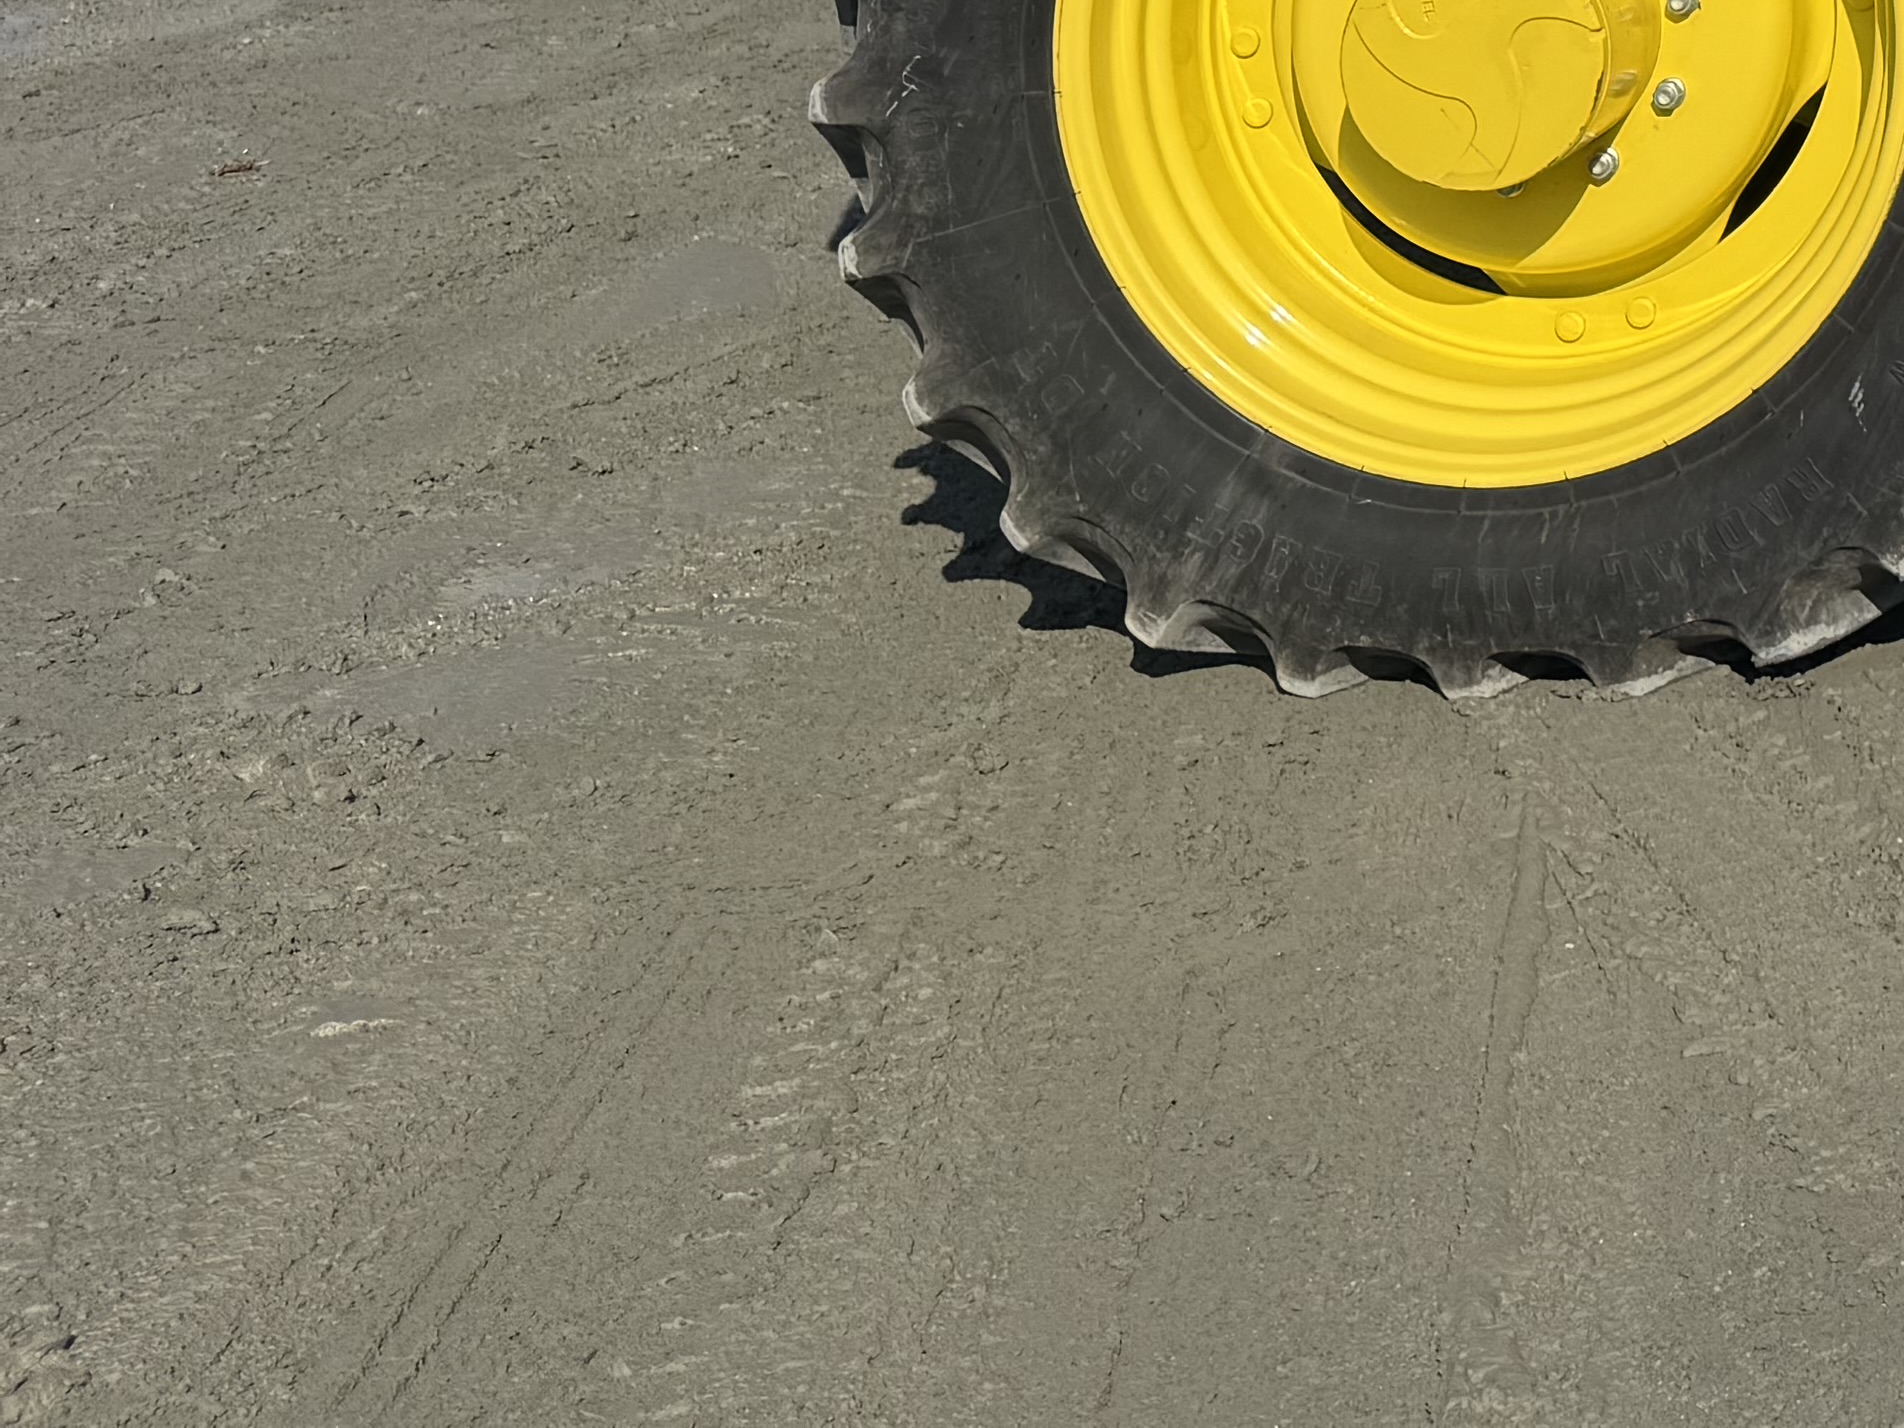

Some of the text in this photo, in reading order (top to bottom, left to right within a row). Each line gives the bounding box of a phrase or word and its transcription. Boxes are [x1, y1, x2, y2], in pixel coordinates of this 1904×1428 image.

[1089, 426, 1387, 607] TRACTION
[1426, 563, 1558, 612] ALL
[1602, 454, 1838, 596] RADIAL
